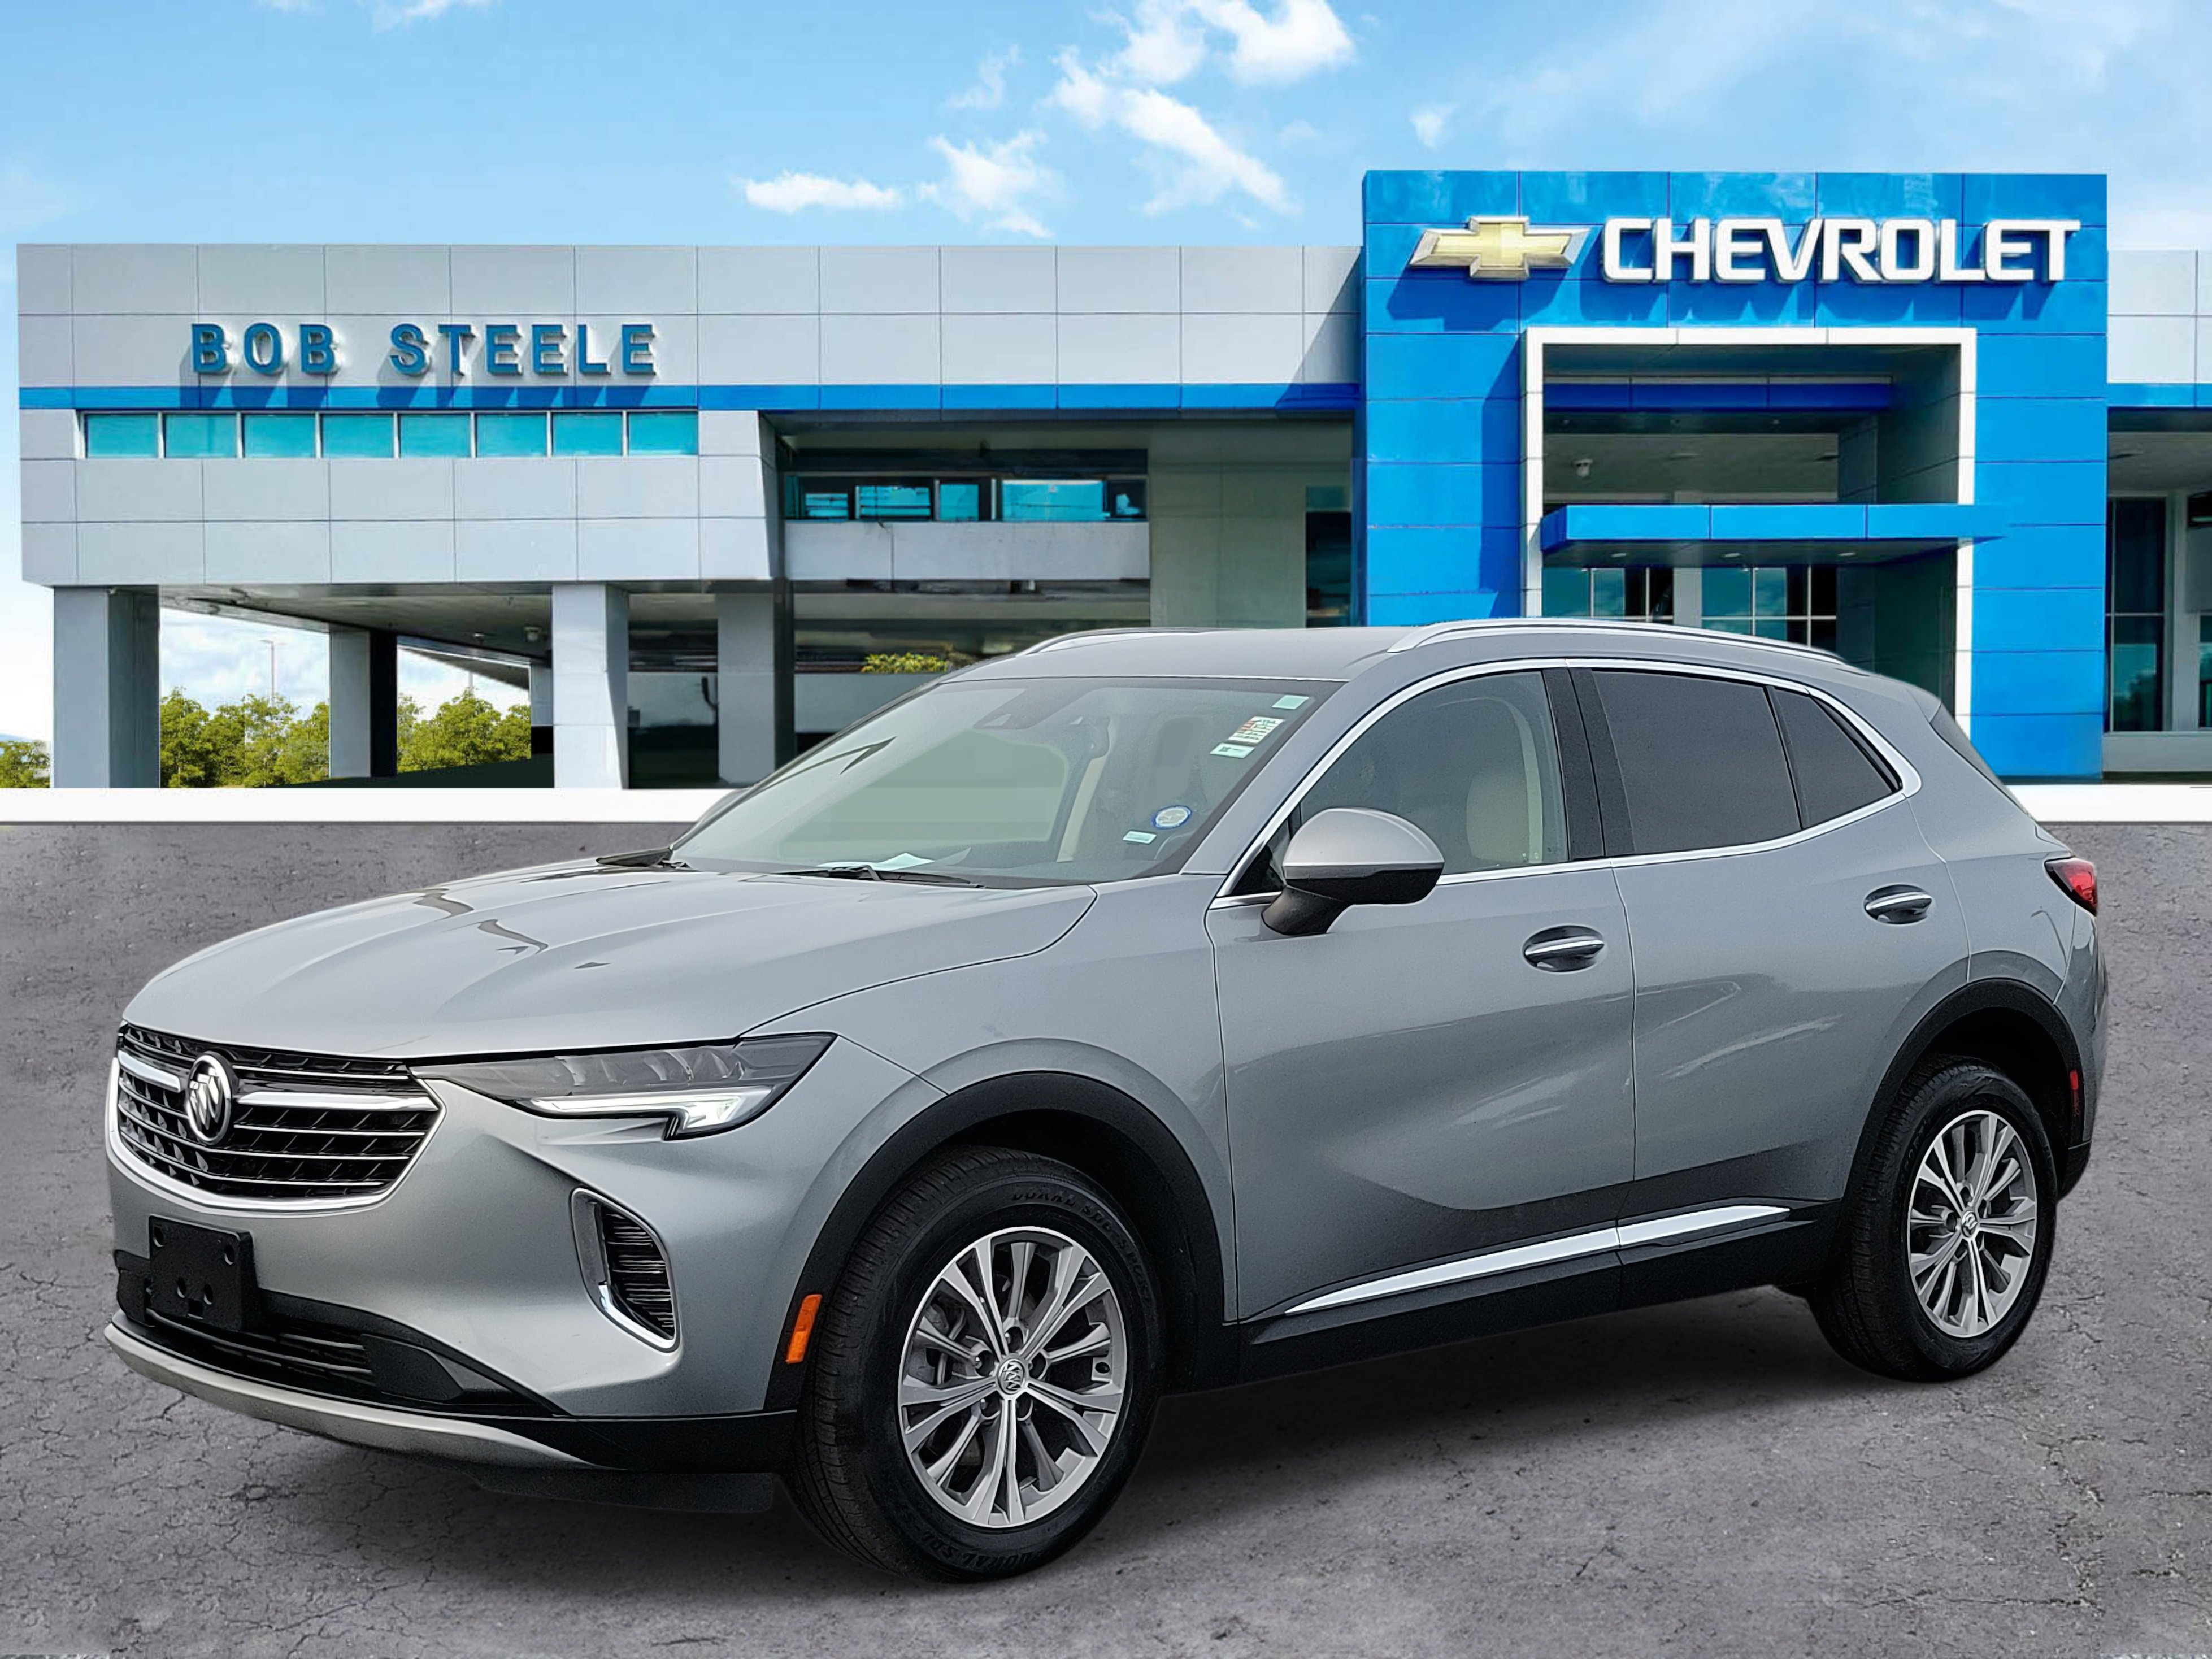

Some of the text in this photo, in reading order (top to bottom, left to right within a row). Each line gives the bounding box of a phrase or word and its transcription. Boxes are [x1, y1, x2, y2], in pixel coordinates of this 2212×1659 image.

[1603, 218, 2081, 282] CHEVROLET
[192, 323, 655, 376] BOB STEELE
